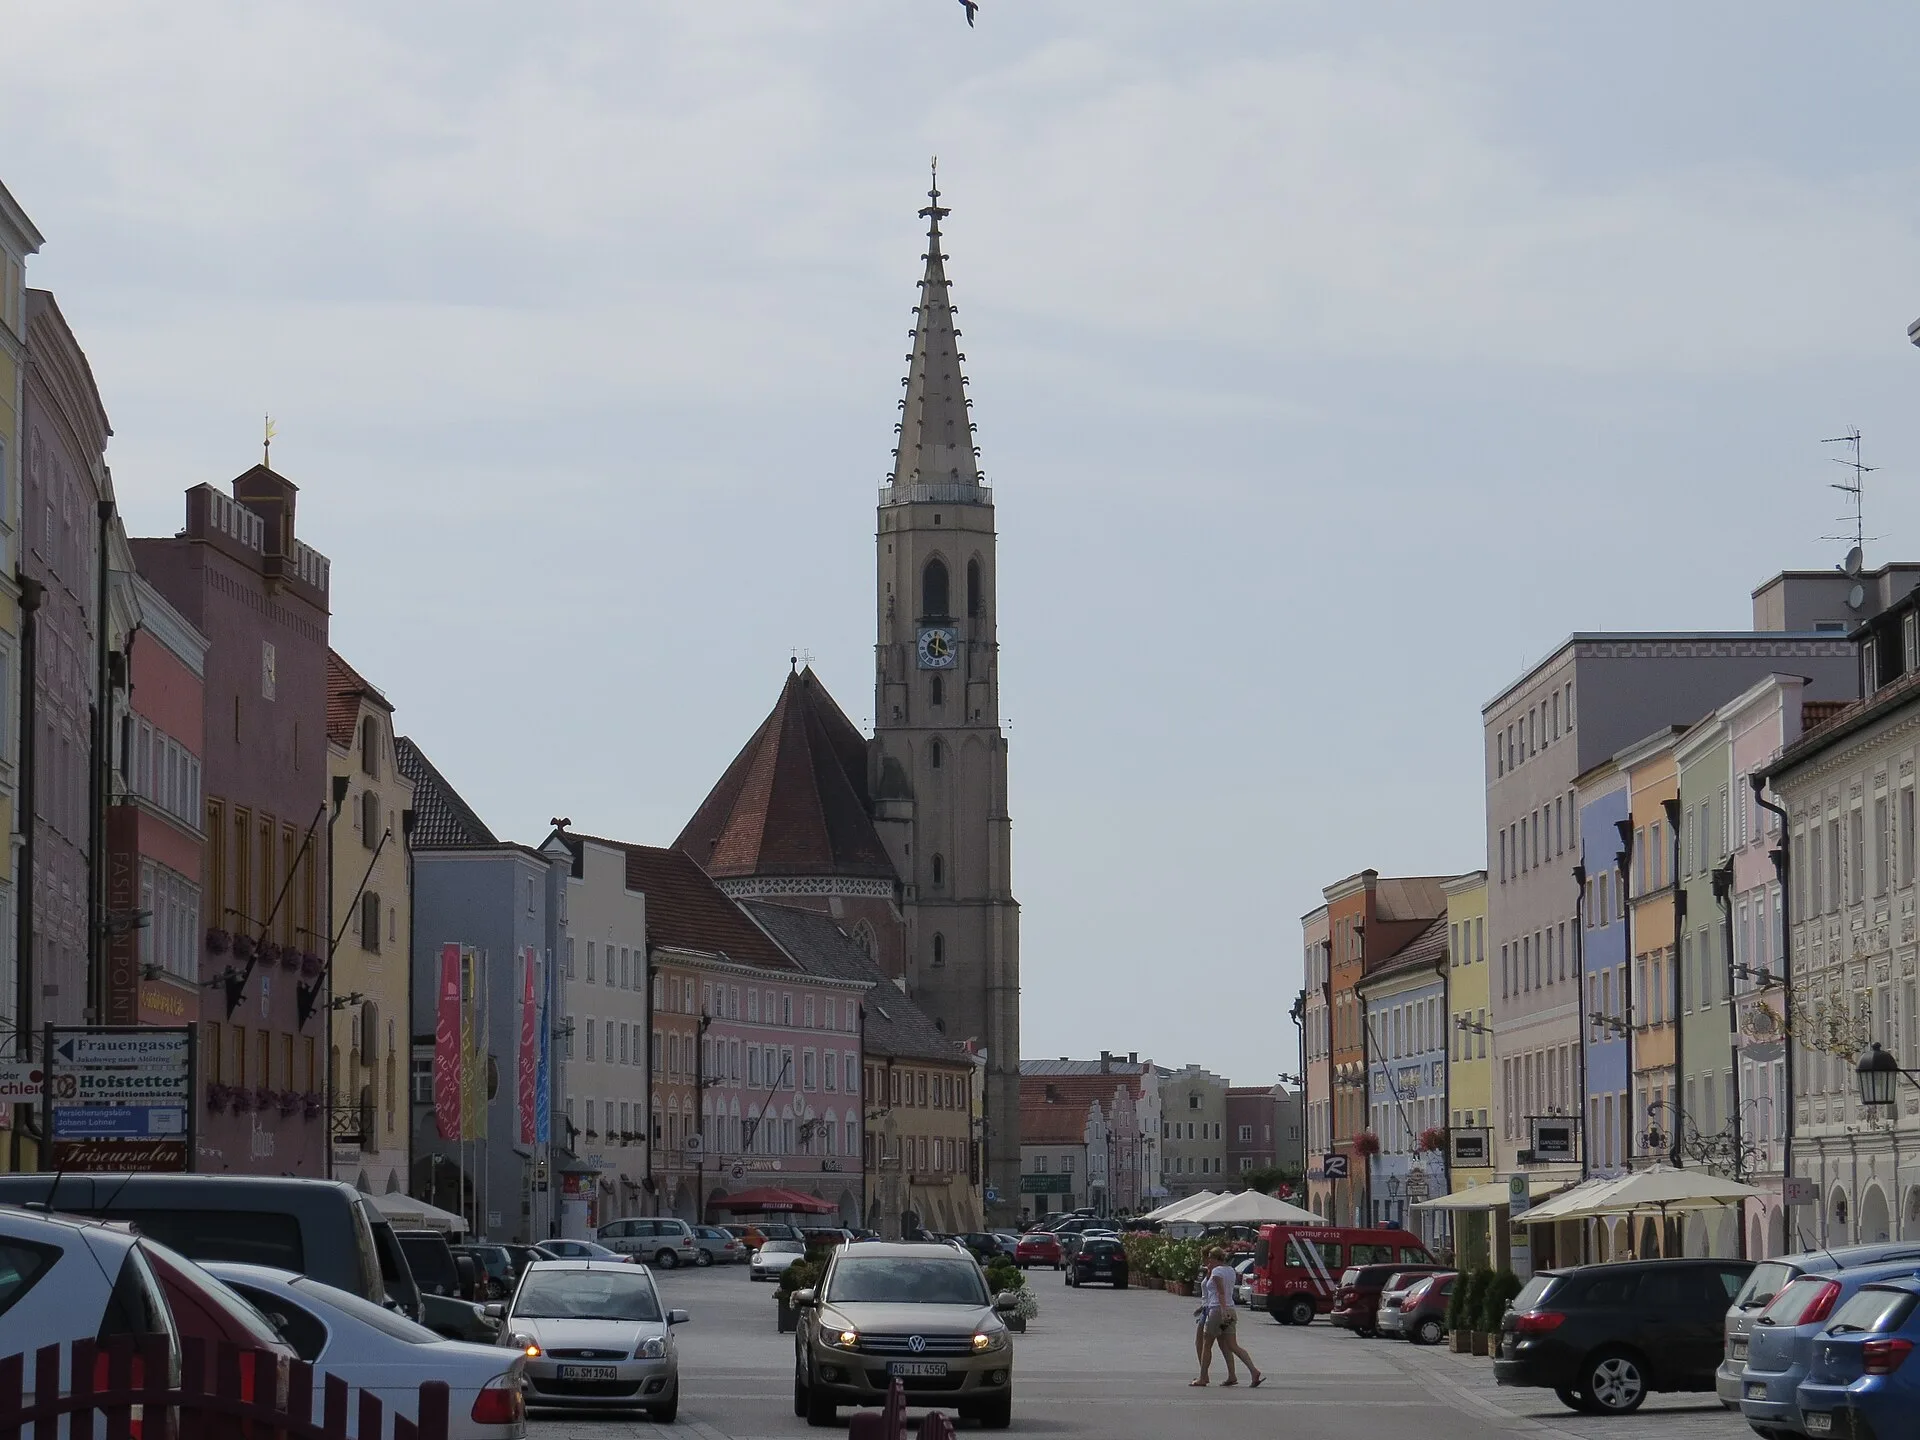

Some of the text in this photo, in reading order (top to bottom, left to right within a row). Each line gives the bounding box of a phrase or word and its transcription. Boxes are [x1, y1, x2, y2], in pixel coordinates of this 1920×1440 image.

[112, 956, 136, 1022] POINT
[78, 1039, 183, 1053] Frauengasse
[118, 1056, 136, 1064] nach
[79, 1075, 184, 1088] Hofstetter
[57, 1109, 132, 1117] Versicherungsbüro
[57, 1118, 86, 1126] Johann
[61, 1143, 178, 1163] Friseursalon
[581, 1368, 592, 1377] SM
[893, 1364, 904, 1373] AÖ
[923, 1365, 945, 1374] 4550
